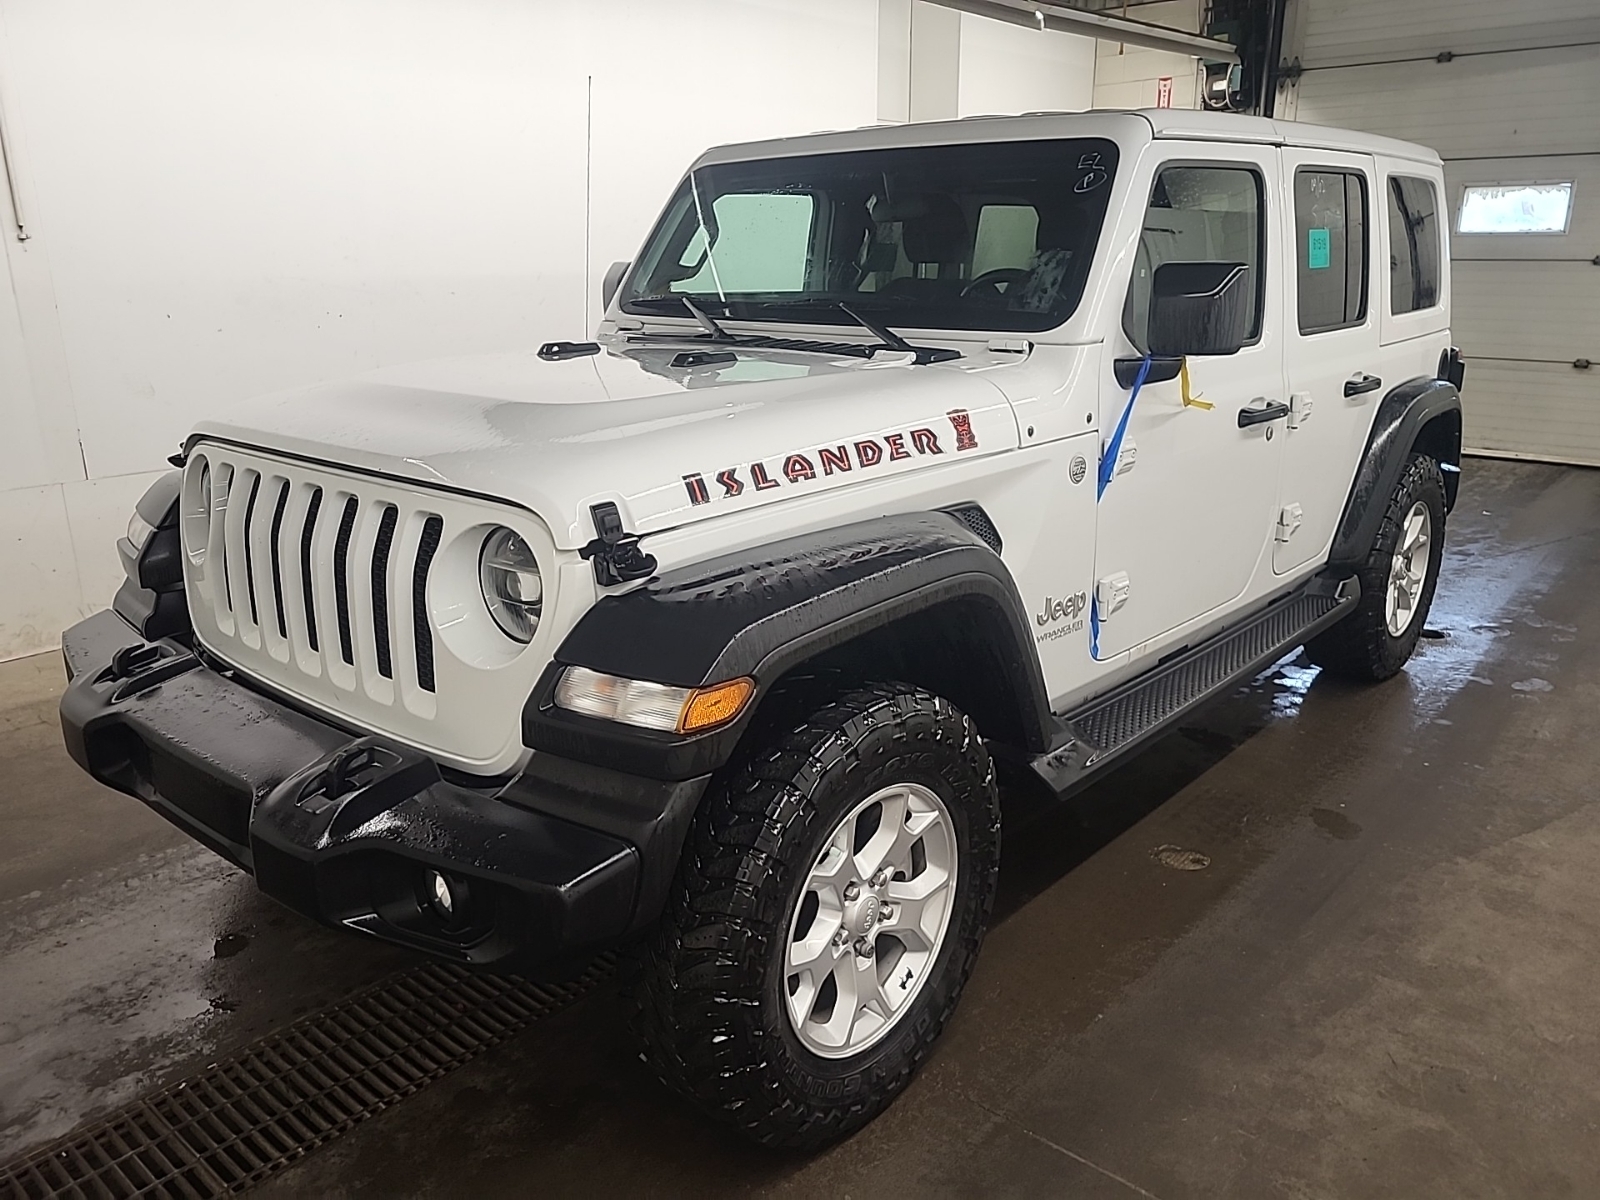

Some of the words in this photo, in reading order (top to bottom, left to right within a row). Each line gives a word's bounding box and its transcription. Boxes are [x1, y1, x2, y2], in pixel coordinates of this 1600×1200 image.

[682, 428, 945, 506] ISLANDER
[1036, 590, 1087, 626] Jeep
[1036, 619, 1083, 643] WRANGLER
